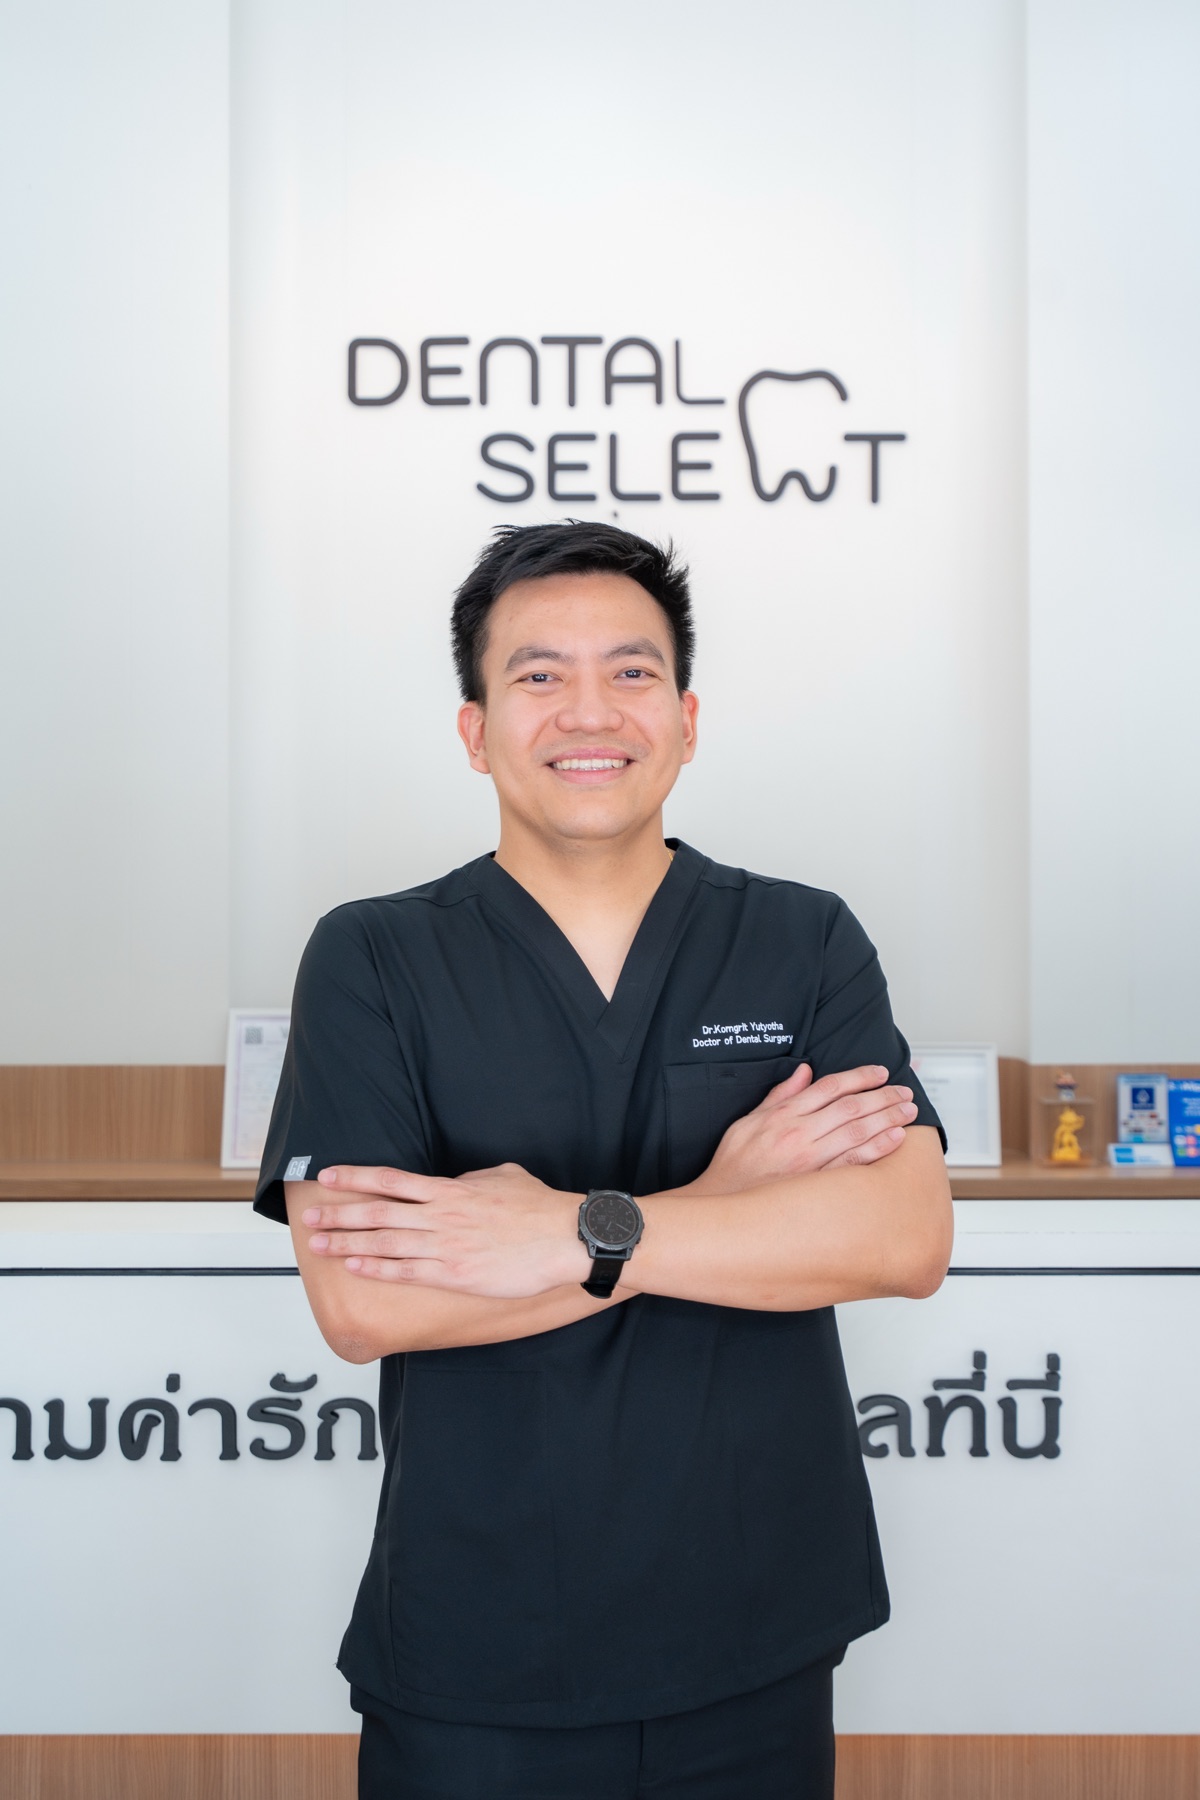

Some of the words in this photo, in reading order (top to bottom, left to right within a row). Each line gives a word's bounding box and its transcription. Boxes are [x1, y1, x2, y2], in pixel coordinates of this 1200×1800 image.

[347, 336, 726, 407] DENTAL
[692, 1038, 721, 1048] Doctor
[724, 1036, 734, 1045] of
[736, 1034, 762, 1044] Dental
[763, 1034, 794, 1044] Surgery
